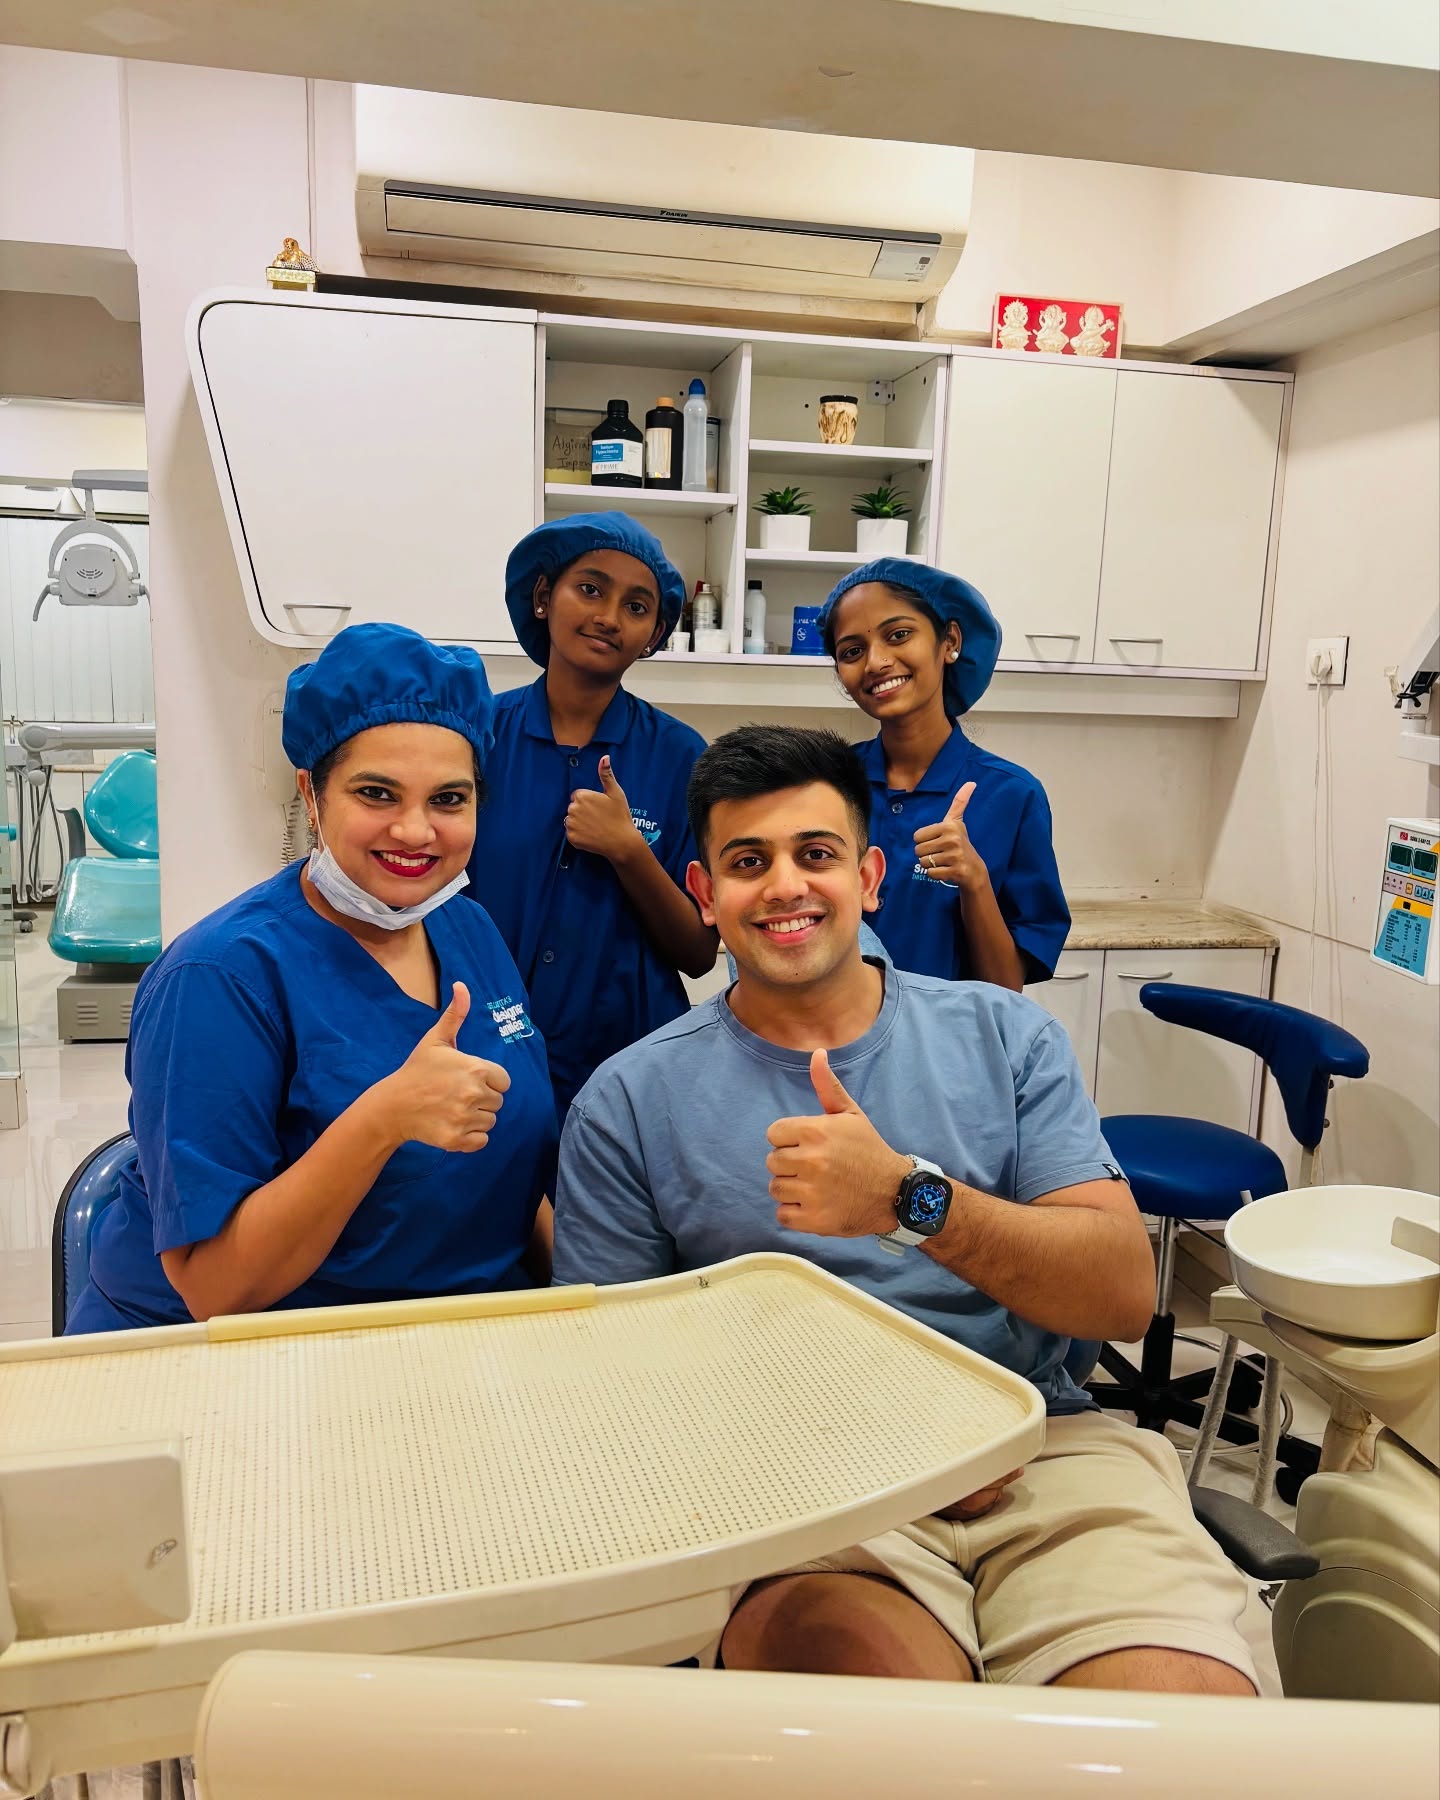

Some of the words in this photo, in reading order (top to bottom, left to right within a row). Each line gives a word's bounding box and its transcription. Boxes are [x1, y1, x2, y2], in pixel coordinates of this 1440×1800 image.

[629, 808, 648, 817] ITA'S
[632, 817, 658, 831] gner
[492, 1002, 525, 1023] designer
[498, 1018, 526, 1037] smiles
